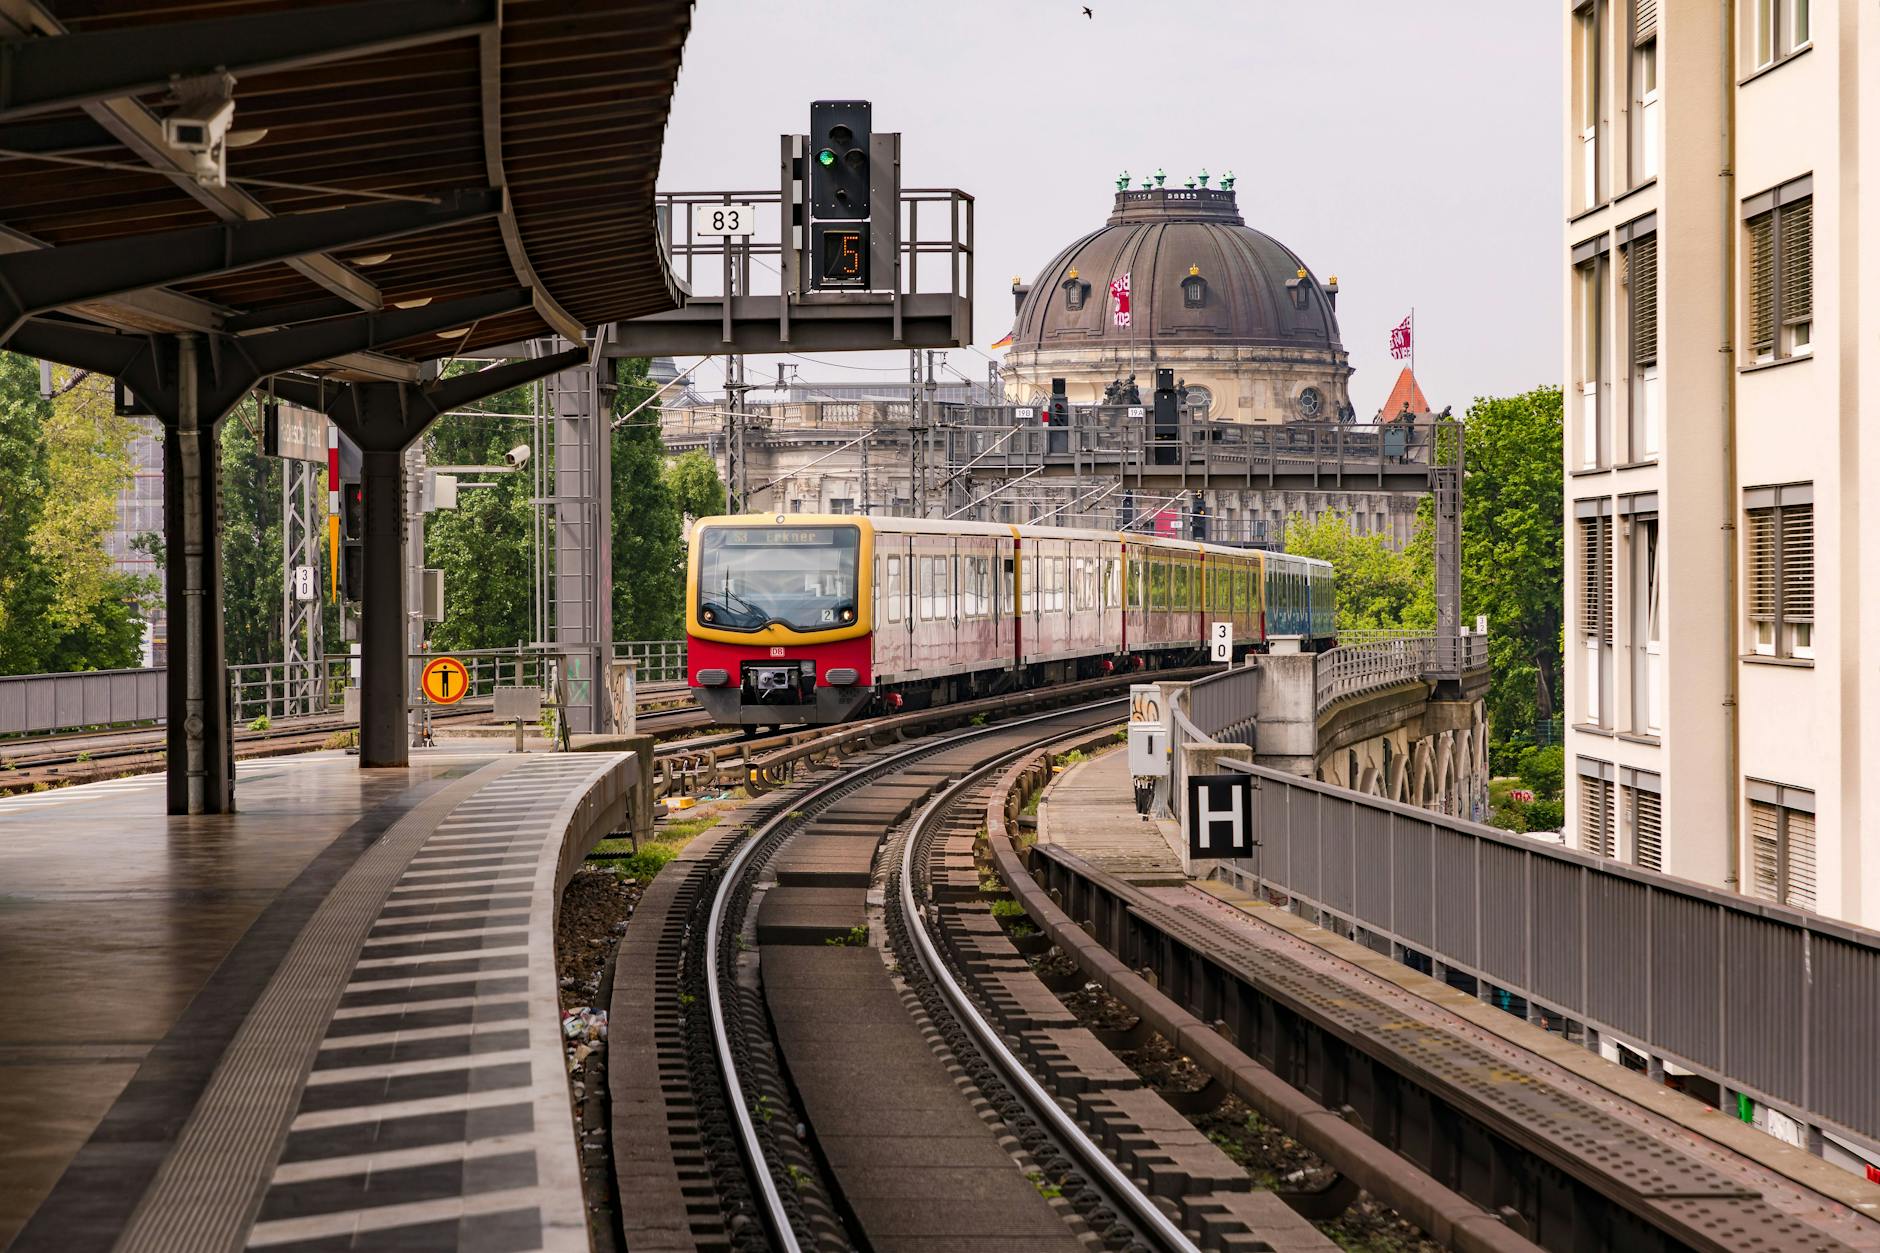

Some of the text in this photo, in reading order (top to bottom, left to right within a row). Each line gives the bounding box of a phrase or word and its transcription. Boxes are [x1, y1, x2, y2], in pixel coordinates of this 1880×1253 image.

[712, 210, 740, 231] 83
[843, 236, 859, 273] 5
[302, 569, 308, 581] 3
[825, 610, 831, 621] 2
[1218, 625, 1226, 638] 3
[771, 647, 784, 656] DB
[1218, 644, 1226, 657] 0
[1198, 785, 1244, 849] H
